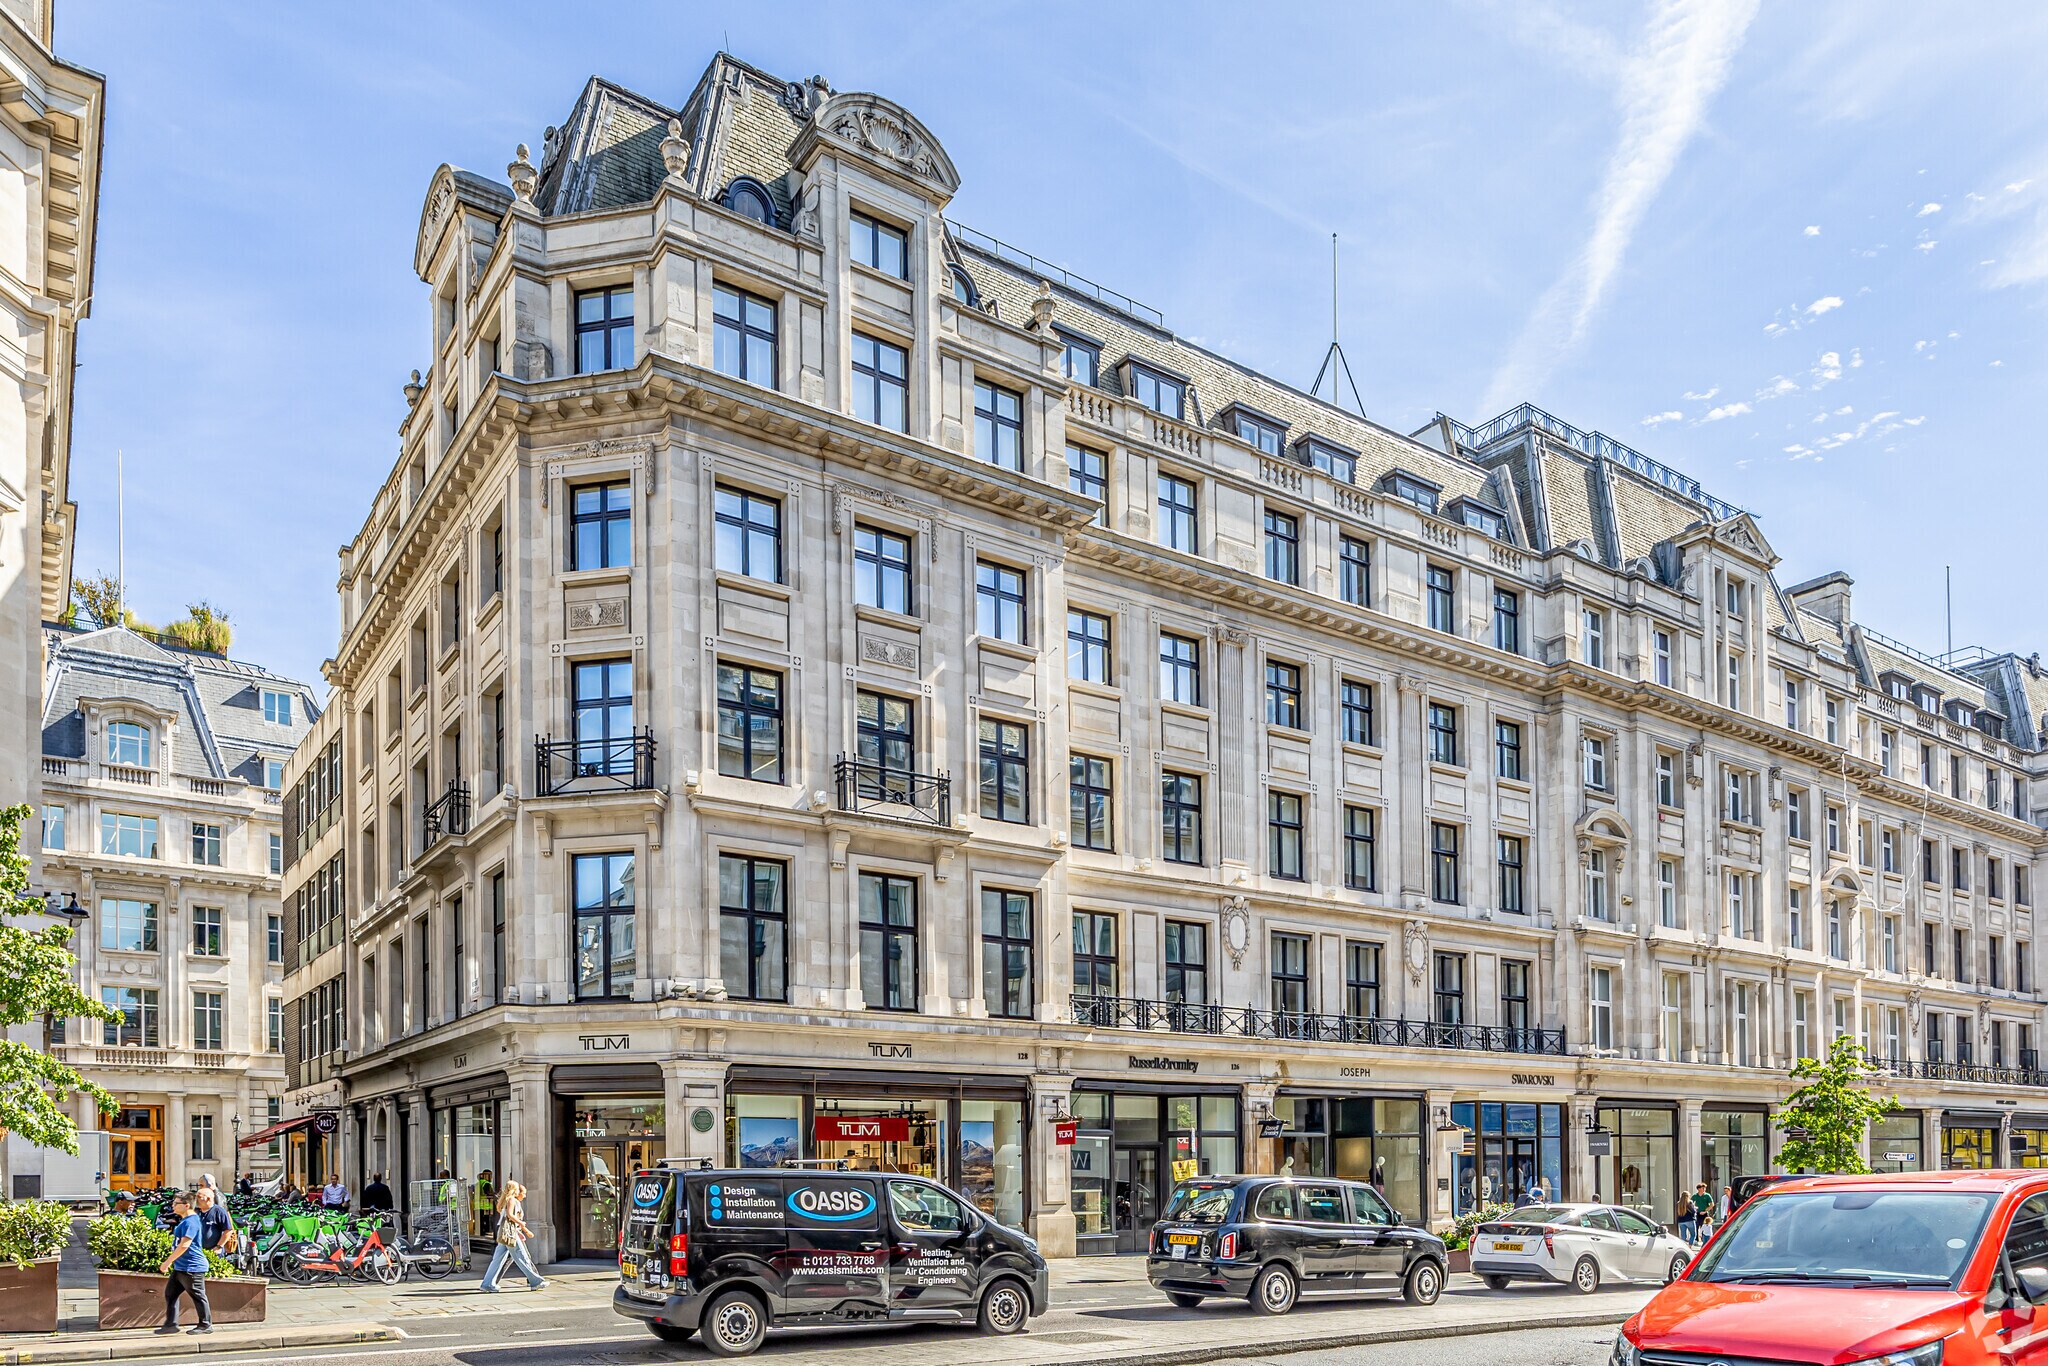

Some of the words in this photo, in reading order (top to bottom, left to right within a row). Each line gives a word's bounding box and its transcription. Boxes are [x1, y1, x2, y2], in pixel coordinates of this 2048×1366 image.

[579, 1034, 630, 1051] TUMI
[868, 1042, 912, 1058] TUMI
[1017, 1052, 1028, 1060] 128
[1340, 1067, 1371, 1077] JOSEPH
[1511, 1073, 1555, 1086] SWAROVSKI
[837, 1121, 881, 1137] TUMI
[636, 1182, 659, 1200] OASIS
[723, 1186, 756, 1197] Design
[725, 1197, 776, 1207] Installation
[800, 1190, 864, 1212] OASIS
[726, 1210, 784, 1220] Maintenance
[920, 1248, 953, 1258] Heating,
[803, 1257, 810, 1266] t:
[812, 1256, 833, 1266] 0121
[836, 1256, 852, 1265] 733
[854, 1255, 875, 1265] 7788
[908, 1258, 949, 1267] Ventilation
[950, 1257, 965, 1266] and
[792, 1265, 885, 1276] www.oasismids.com
[905, 1267, 917, 1276] Air
[918, 1266, 968, 1277] Conditioning
[917, 1276, 957, 1286] Engineers
